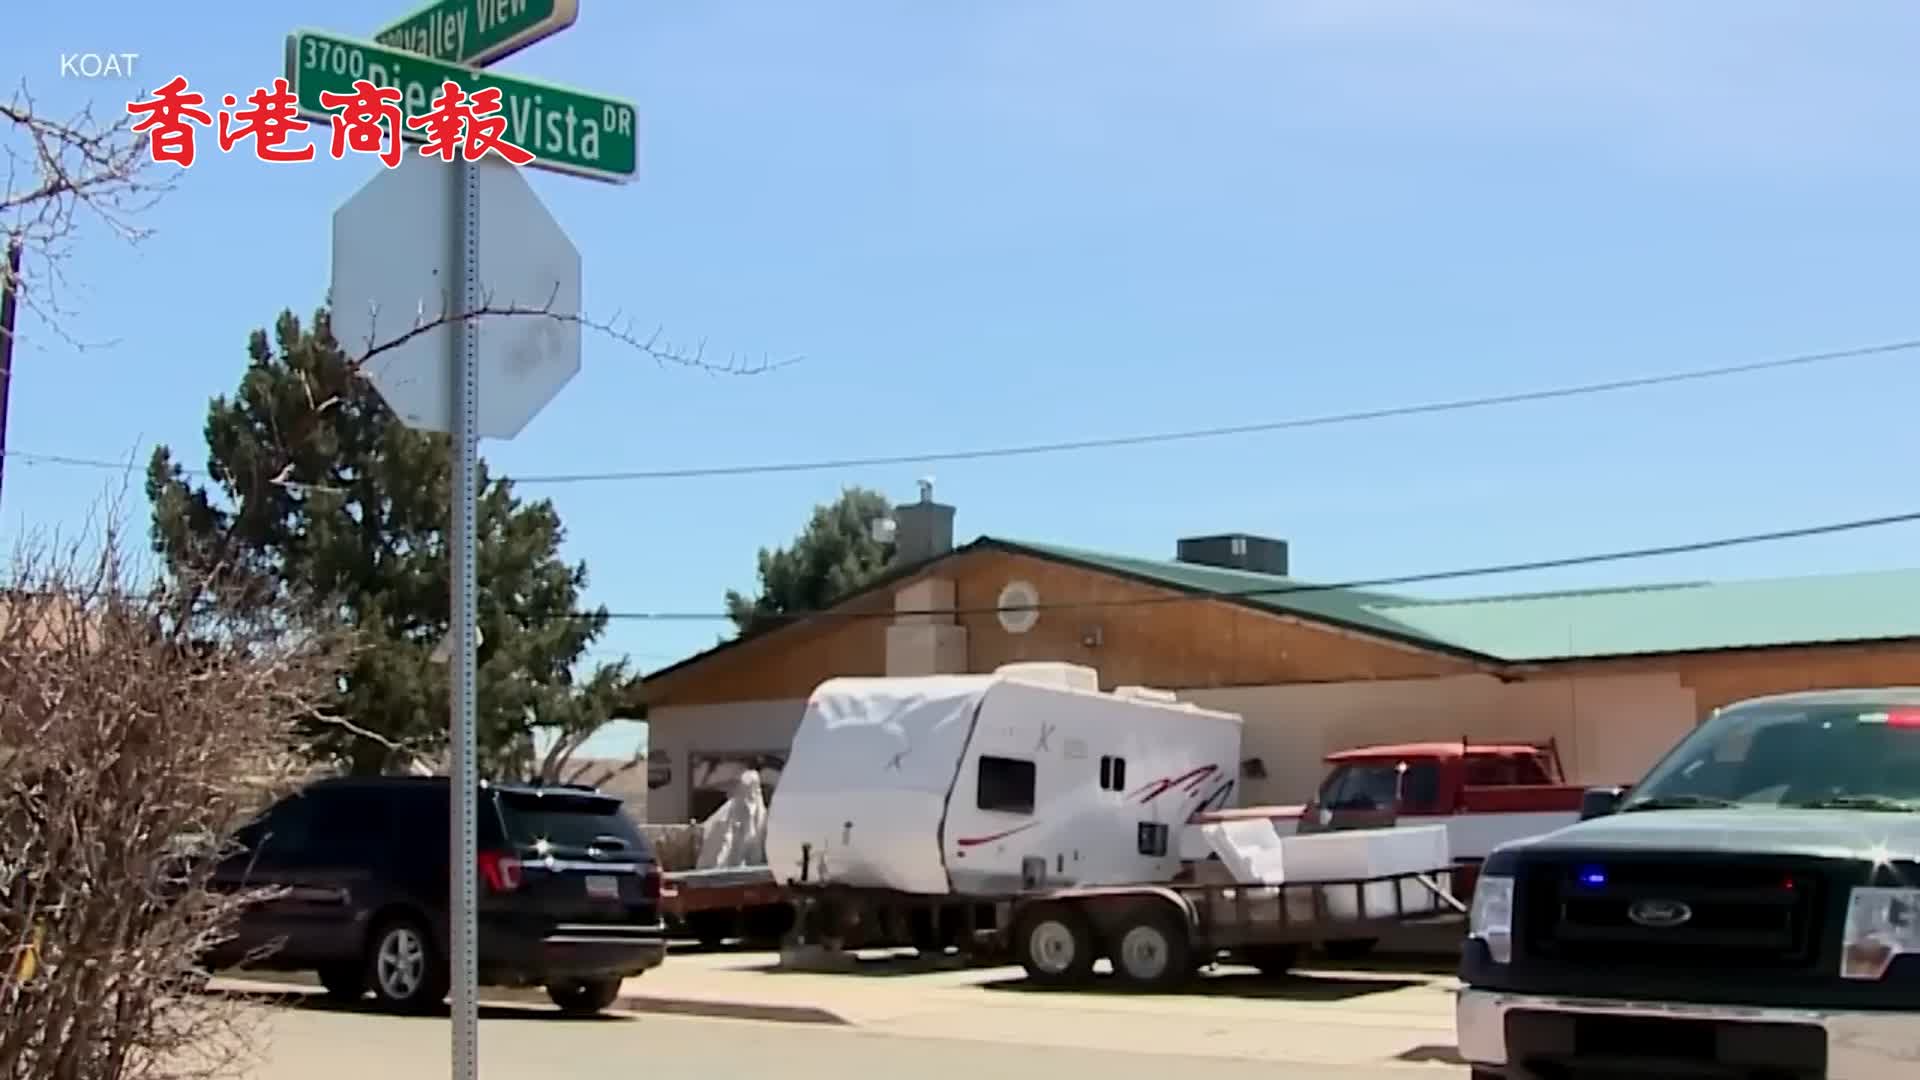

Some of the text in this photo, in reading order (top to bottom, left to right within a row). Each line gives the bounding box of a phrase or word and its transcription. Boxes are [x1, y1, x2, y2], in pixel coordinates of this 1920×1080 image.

[304, 38, 365, 78] 3700
[509, 94, 600, 160] Vista
[602, 104, 631, 137] DR
